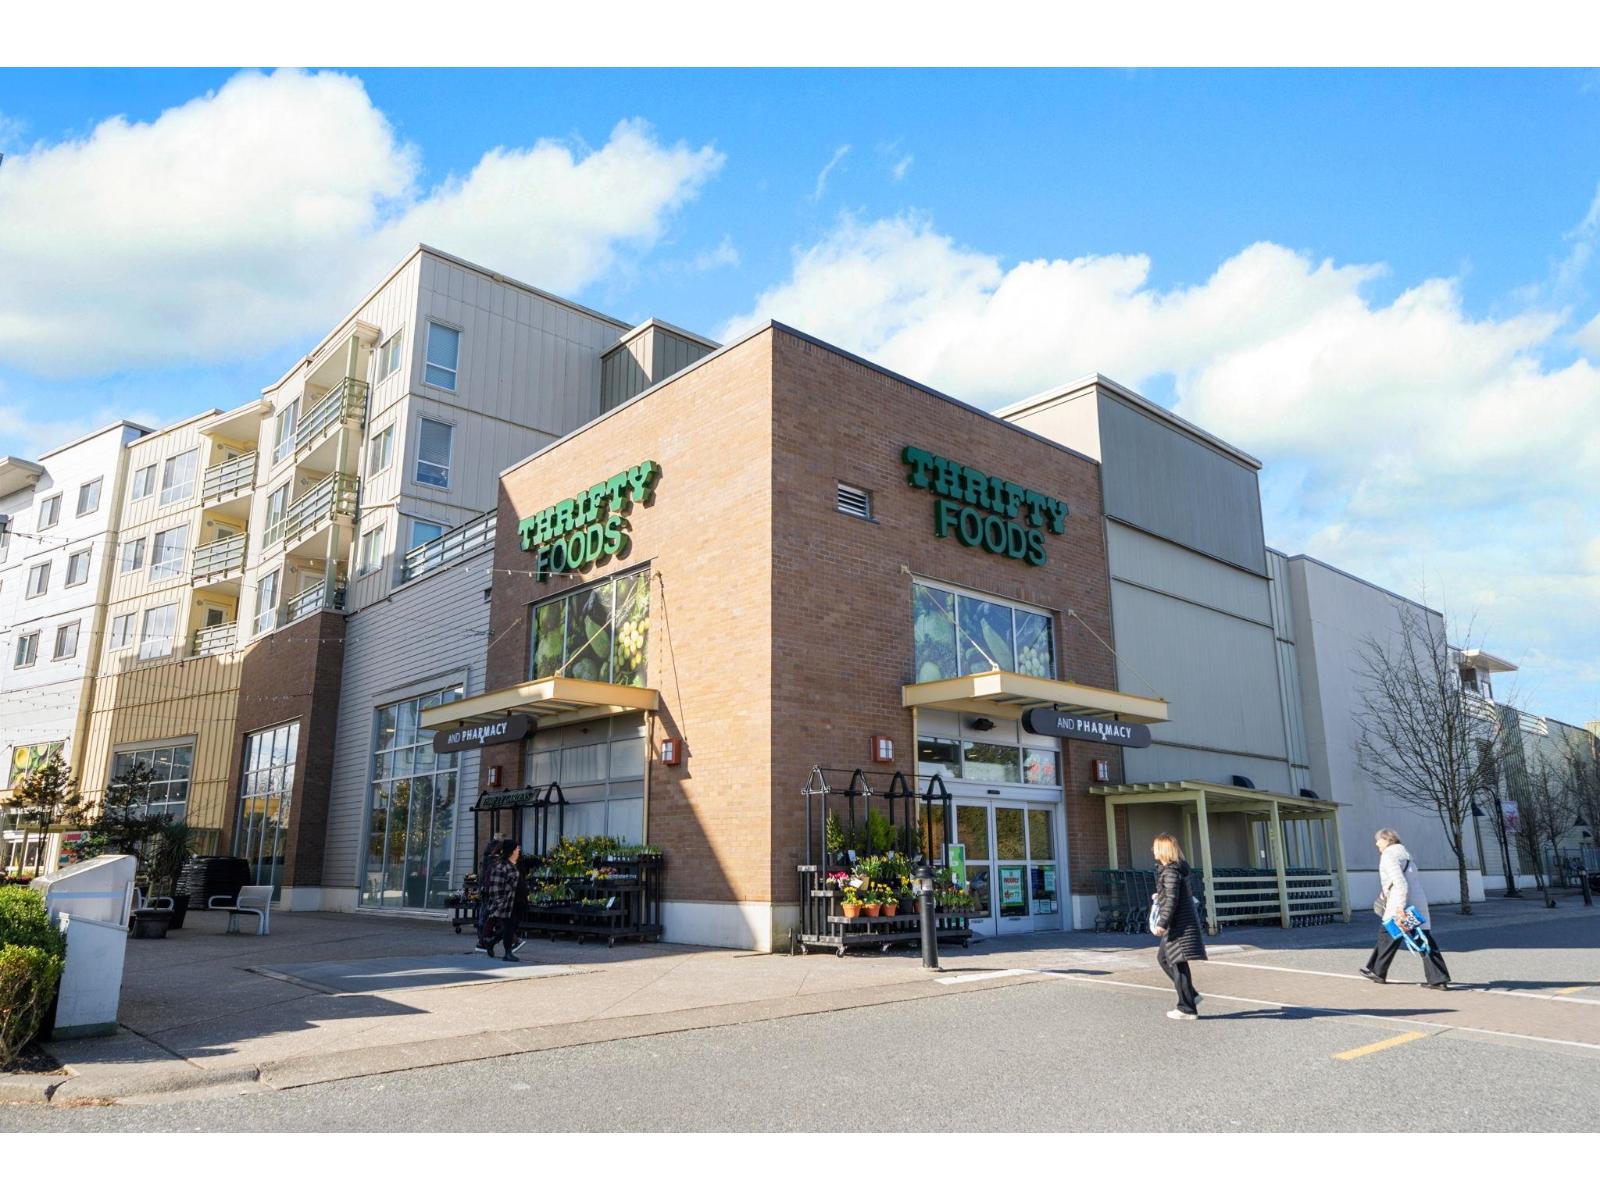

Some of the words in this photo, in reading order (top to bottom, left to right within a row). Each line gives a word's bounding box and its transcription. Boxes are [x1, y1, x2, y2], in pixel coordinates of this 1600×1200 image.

[517, 459, 659, 551] THRIFTY
[902, 446, 1069, 535] THRIFTY
[535, 514, 629, 582] FOODS
[934, 499, 1048, 567] FOODS
[447, 732, 461, 744] AND
[461, 721, 508, 744] PHARMACY
[1057, 717, 1075, 730] AND
[1076, 719, 1132, 741] PHARMACY
